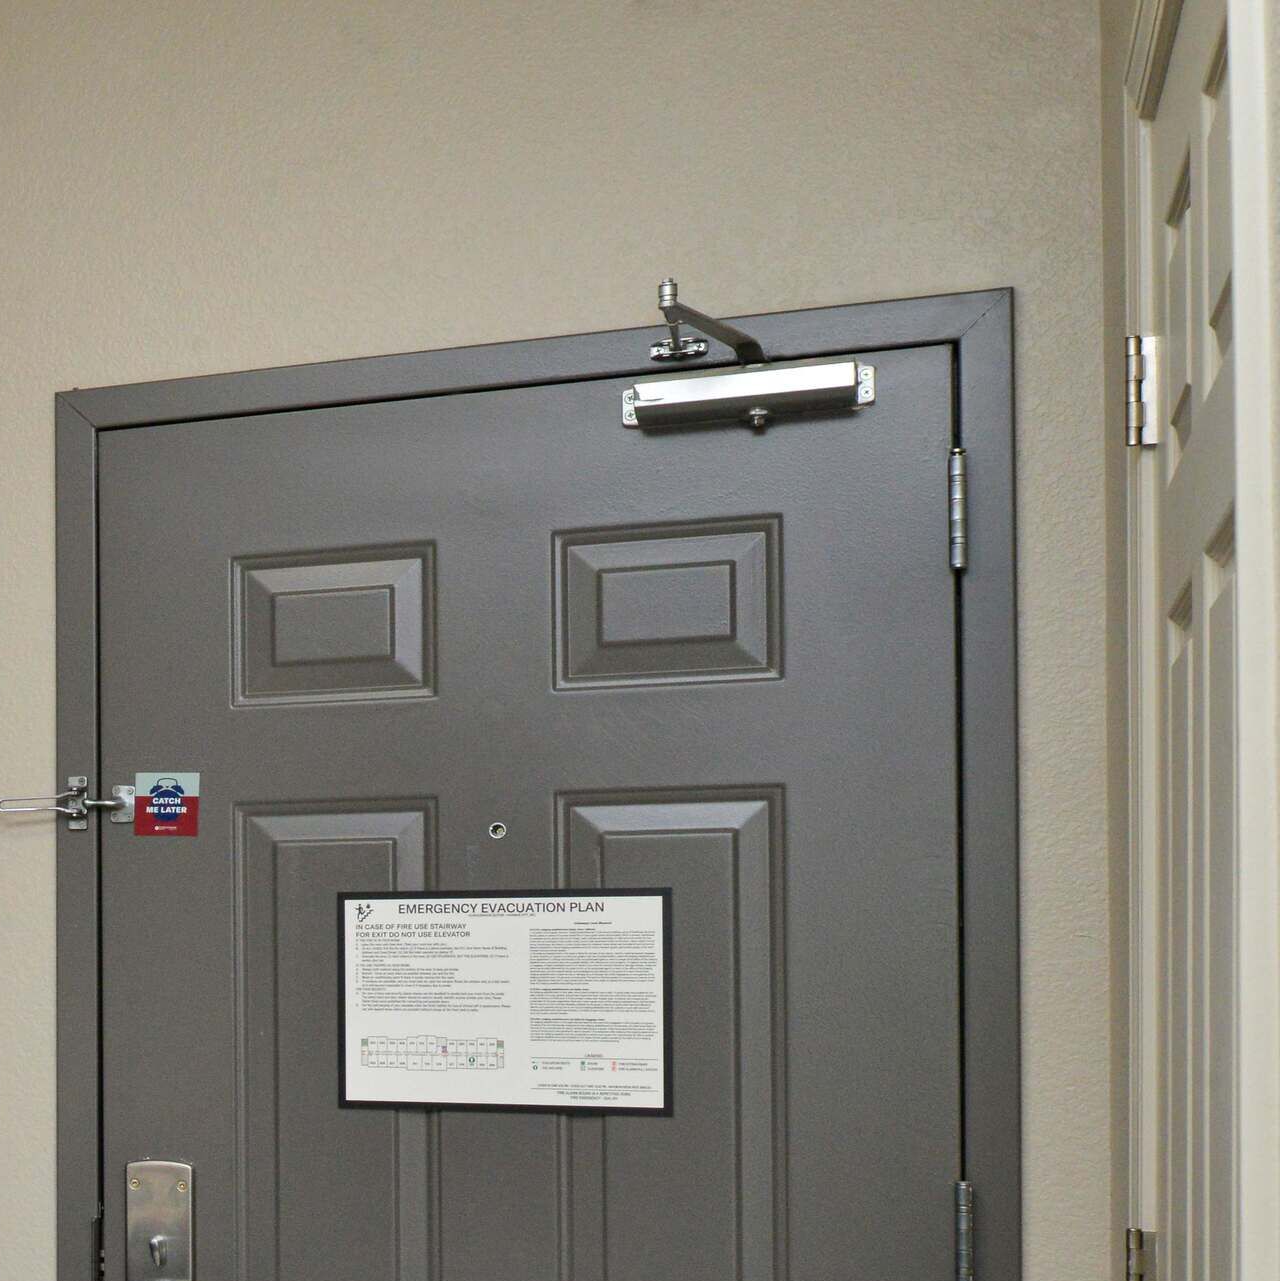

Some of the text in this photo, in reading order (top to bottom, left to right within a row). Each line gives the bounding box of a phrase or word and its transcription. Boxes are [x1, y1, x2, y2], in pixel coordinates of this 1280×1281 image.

[398, 902, 605, 914] EMERGENCY EVACUATION PLAN
